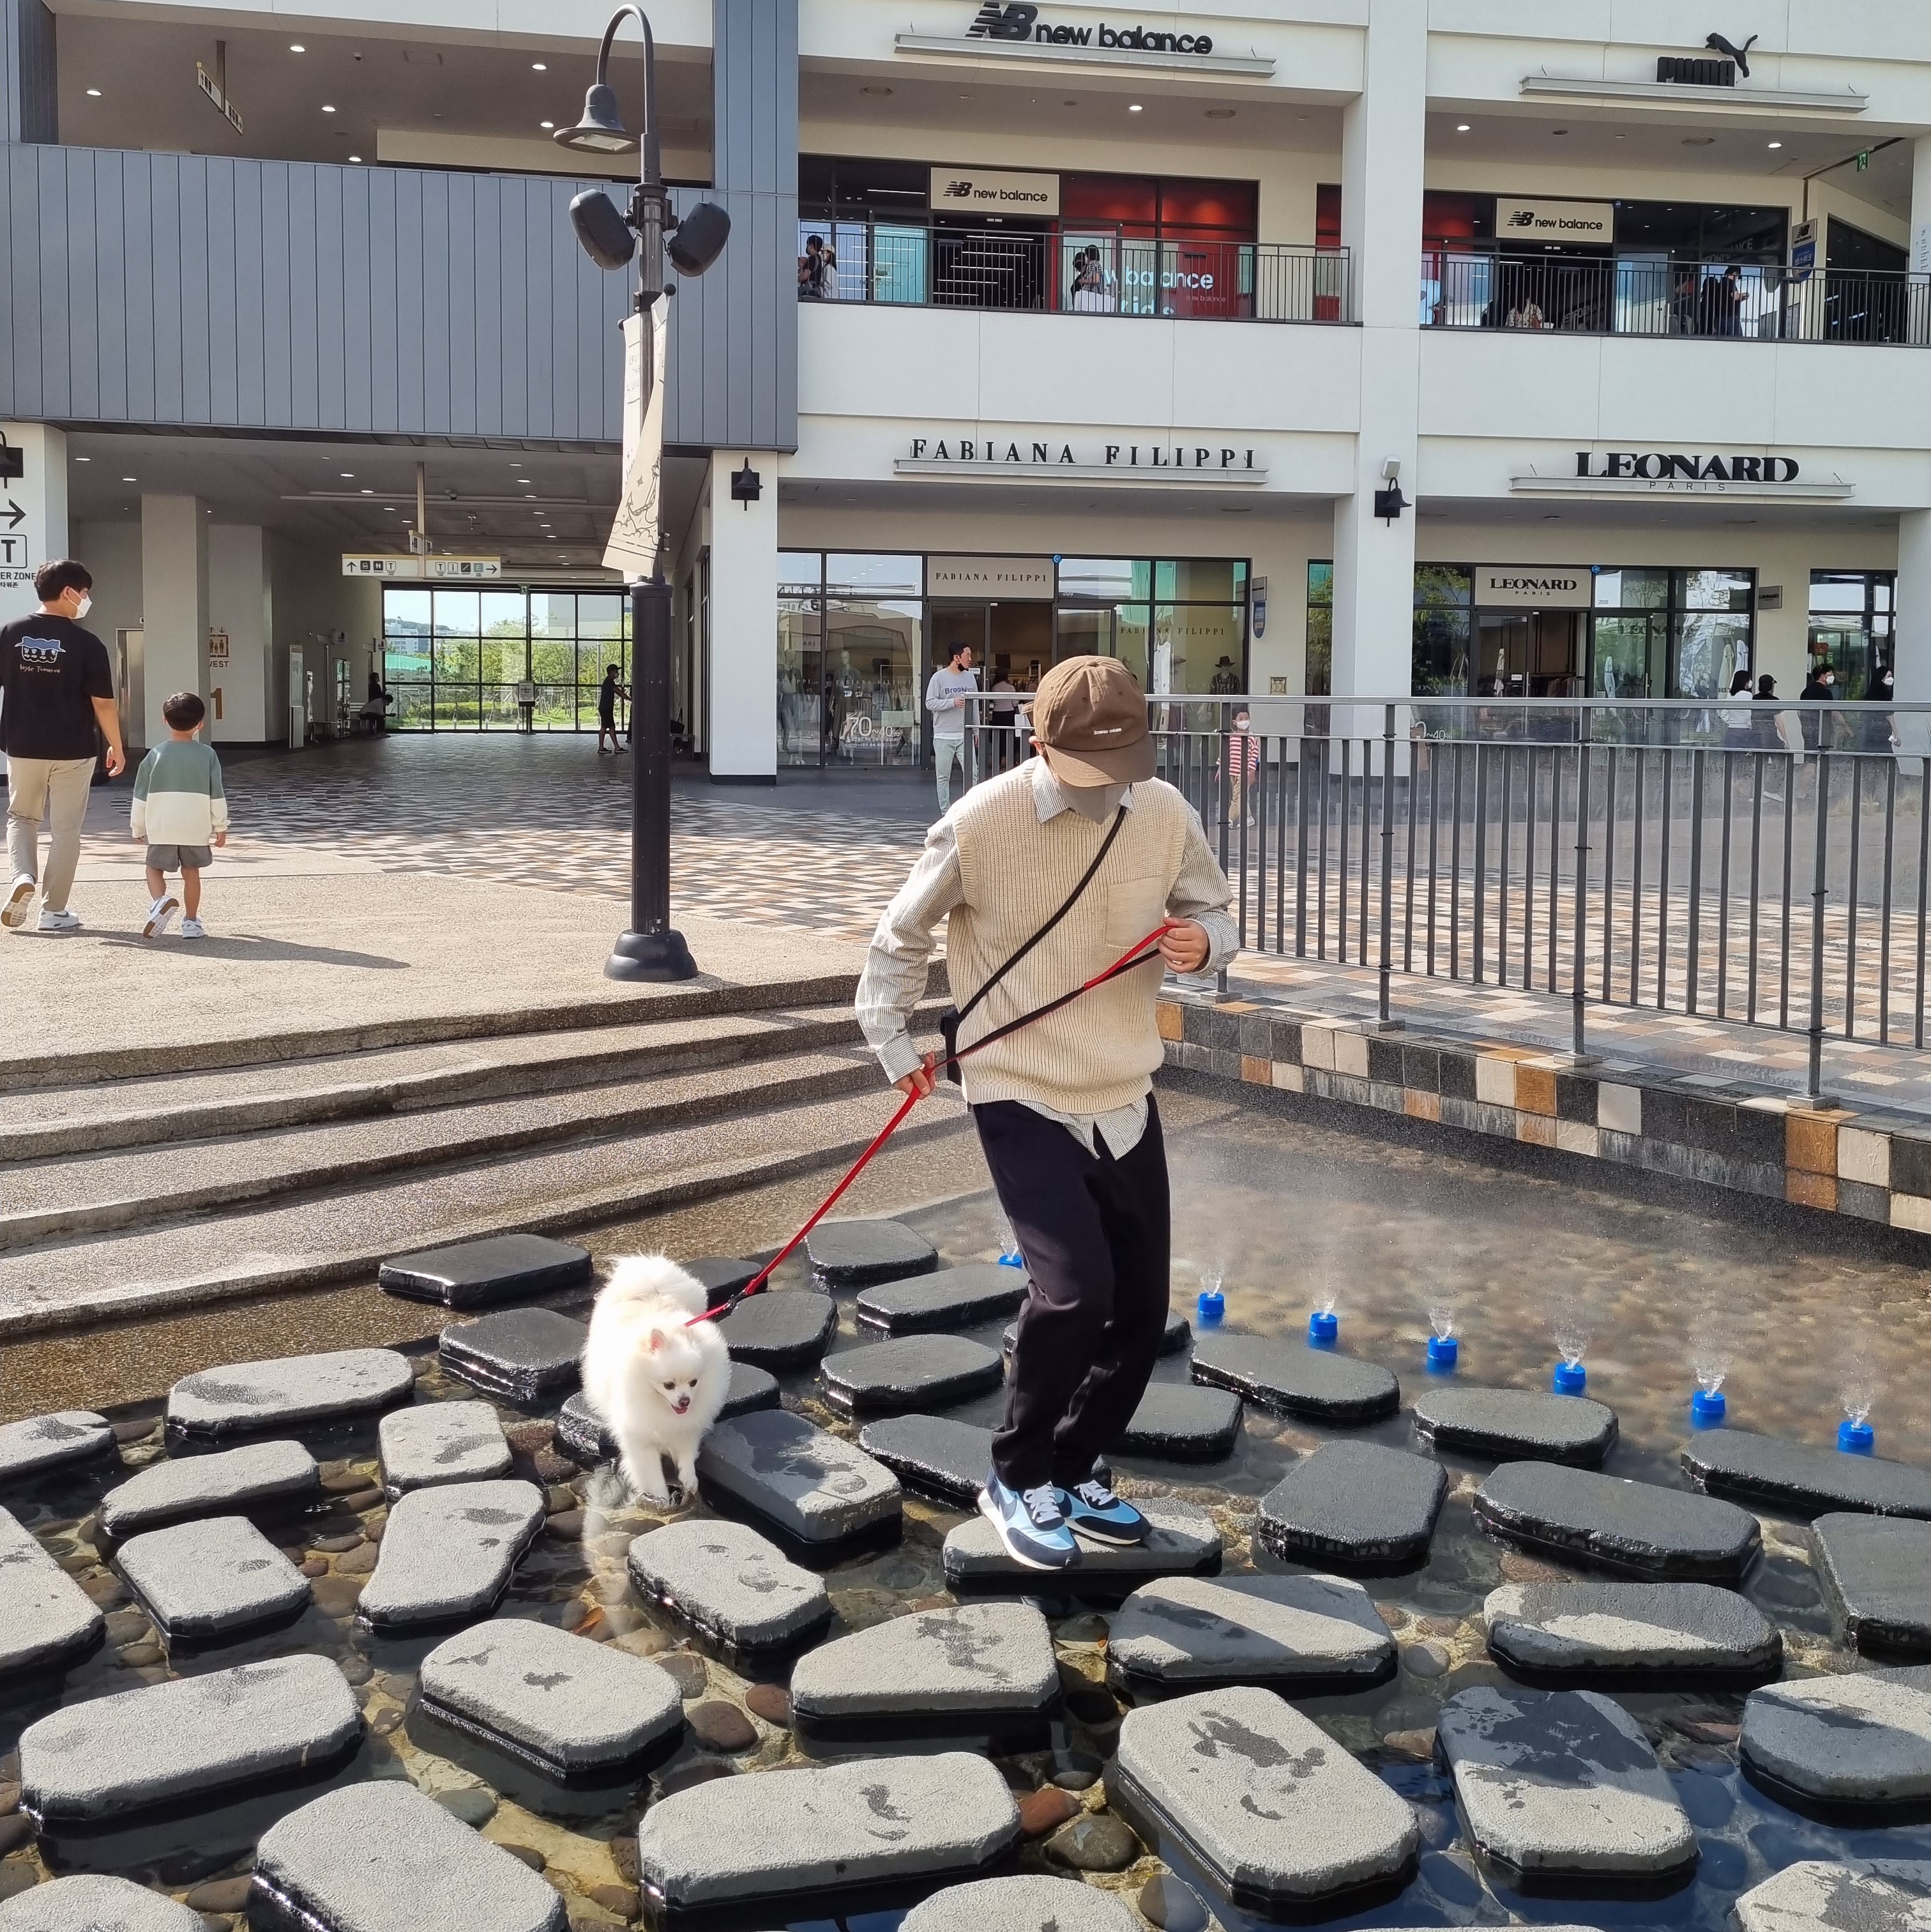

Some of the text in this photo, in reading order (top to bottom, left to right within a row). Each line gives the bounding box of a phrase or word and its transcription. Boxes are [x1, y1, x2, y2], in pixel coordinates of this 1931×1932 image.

[1036, 24, 1093, 46] new
[1099, 23, 1213, 54] balance
[1657, 57, 1735, 87] PUMA
[974, 190, 997, 199] new
[1001, 189, 1048, 202] balance
[1535, 219, 1557, 228] new
[1559, 218, 1603, 230] balance
[1126, 266, 1213, 289] baance
[912, 439, 1255, 469] FABIANA FILIPPI
[1575, 452, 1799, 482] LEONARD
[1649, 481, 1725, 491] PARIS
[14, 572, 36, 581] ZONE
[935, 572, 1047, 582] FABIANA FILIPPI
[1490, 578, 1577, 590] LEONARD
